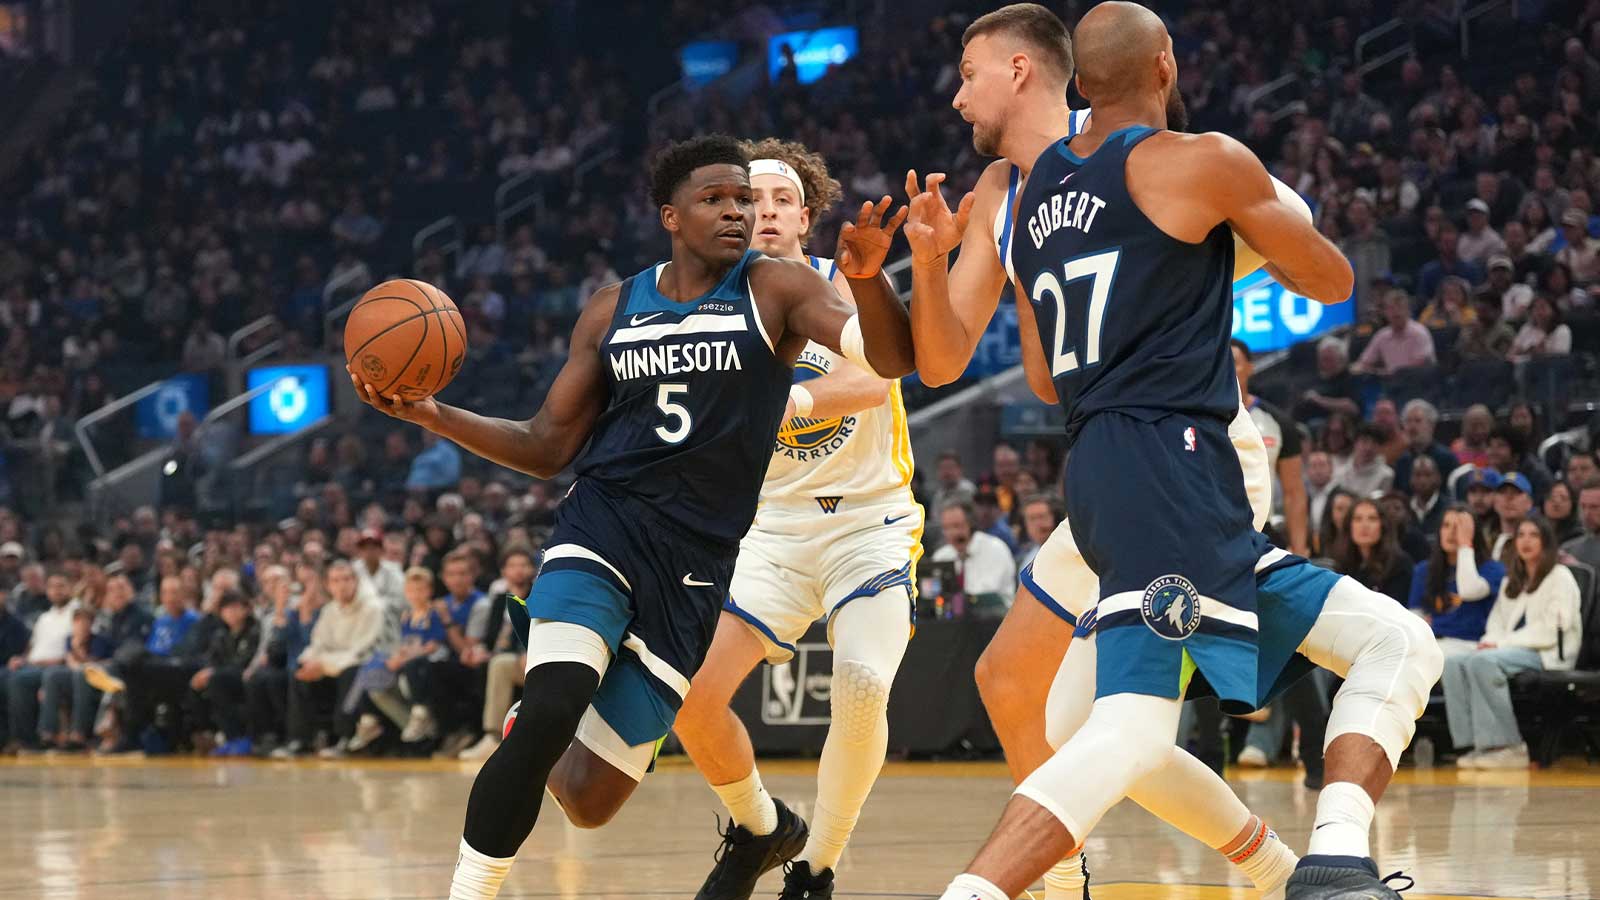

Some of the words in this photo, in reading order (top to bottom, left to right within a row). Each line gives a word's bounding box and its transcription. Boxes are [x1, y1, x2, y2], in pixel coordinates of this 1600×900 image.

[1028, 191, 1106, 250] GOBERT
[703, 302, 734, 312] sezzle
[1032, 250, 1120, 378] 27
[609, 340, 742, 382] MINNESOTA
[655, 383, 692, 443] 5
[1143, 578, 1171, 617] MINNESOTA
